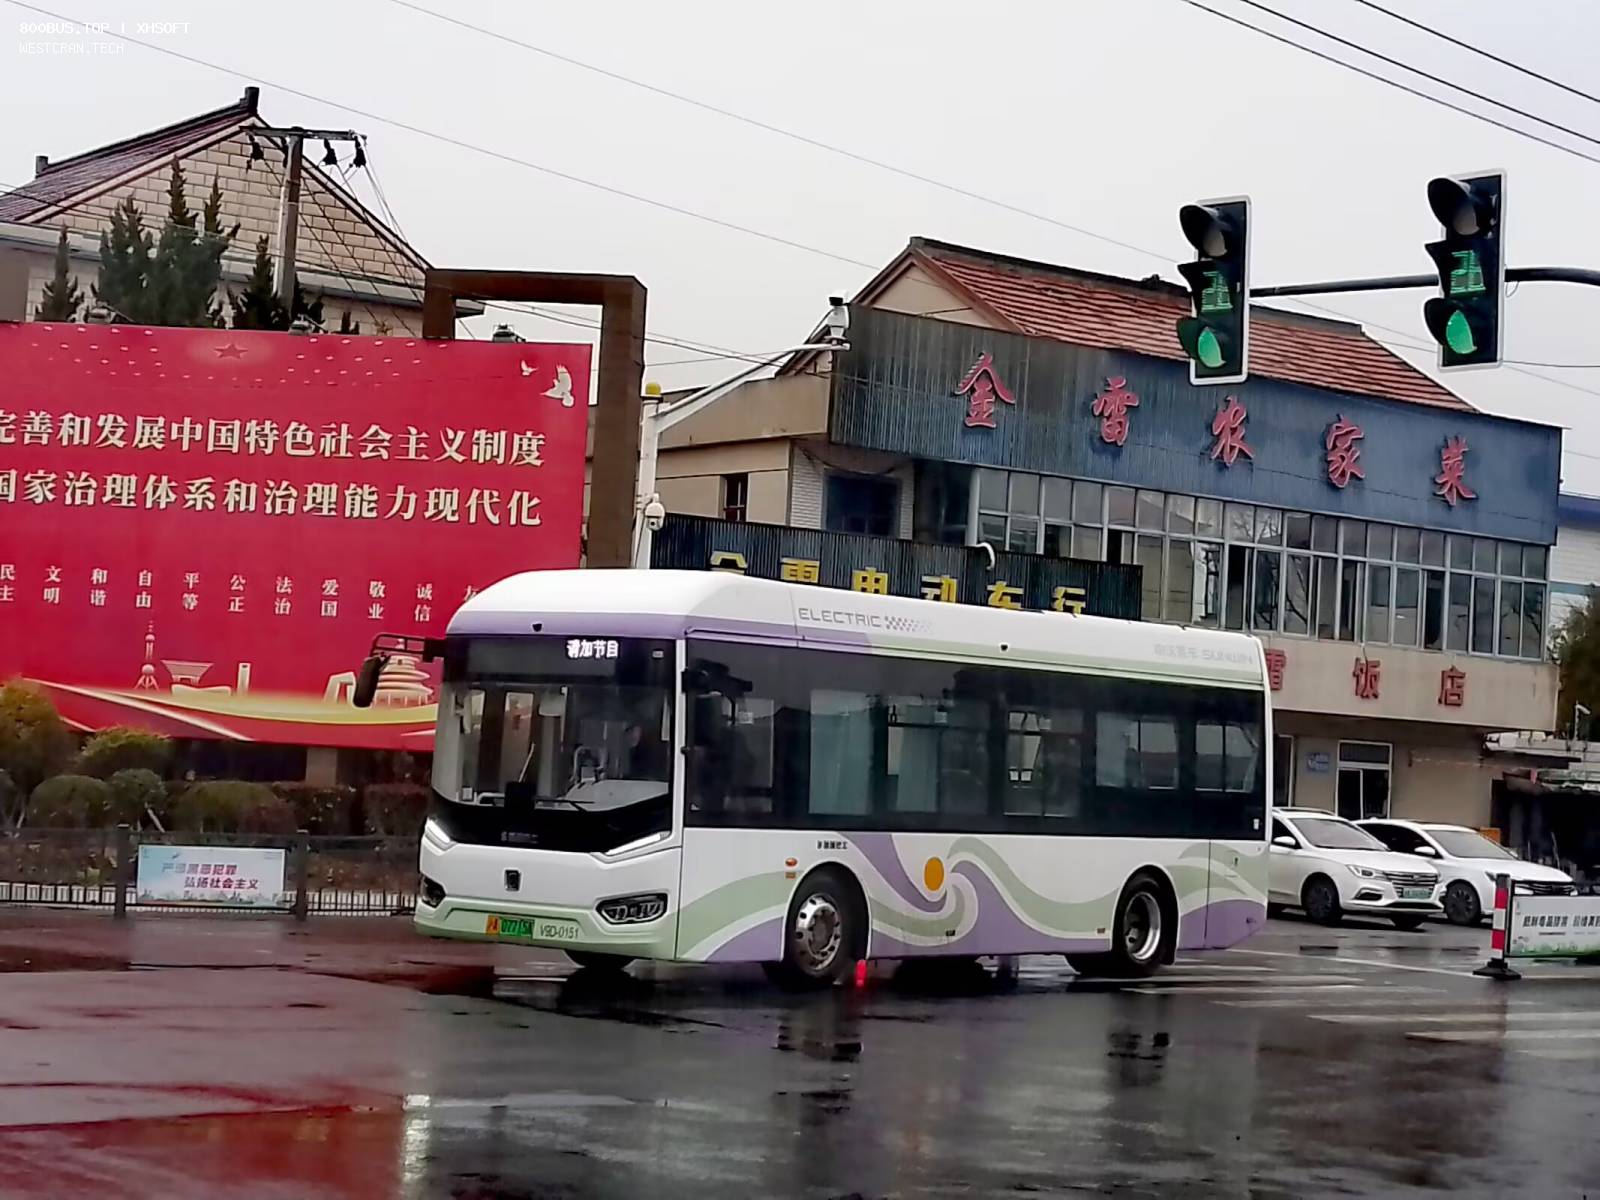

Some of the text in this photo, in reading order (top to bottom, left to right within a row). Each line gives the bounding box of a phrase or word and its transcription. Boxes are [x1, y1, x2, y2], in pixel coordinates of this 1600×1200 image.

[954, 352, 1477, 507] 金雷农家菜
[43, 565, 62, 604] 文明
[90, 567, 108, 607] 和谐
[135, 570, 152, 609] 自由
[182, 572, 200, 611] 平等
[228, 574, 246, 613] 公正
[274, 576, 293, 615] 法治
[320, 579, 339, 617] 爱国
[367, 581, 386, 620] 敬业
[414, 583, 433, 622] 诚信
[798, 607, 883, 628] ELECTRIC
